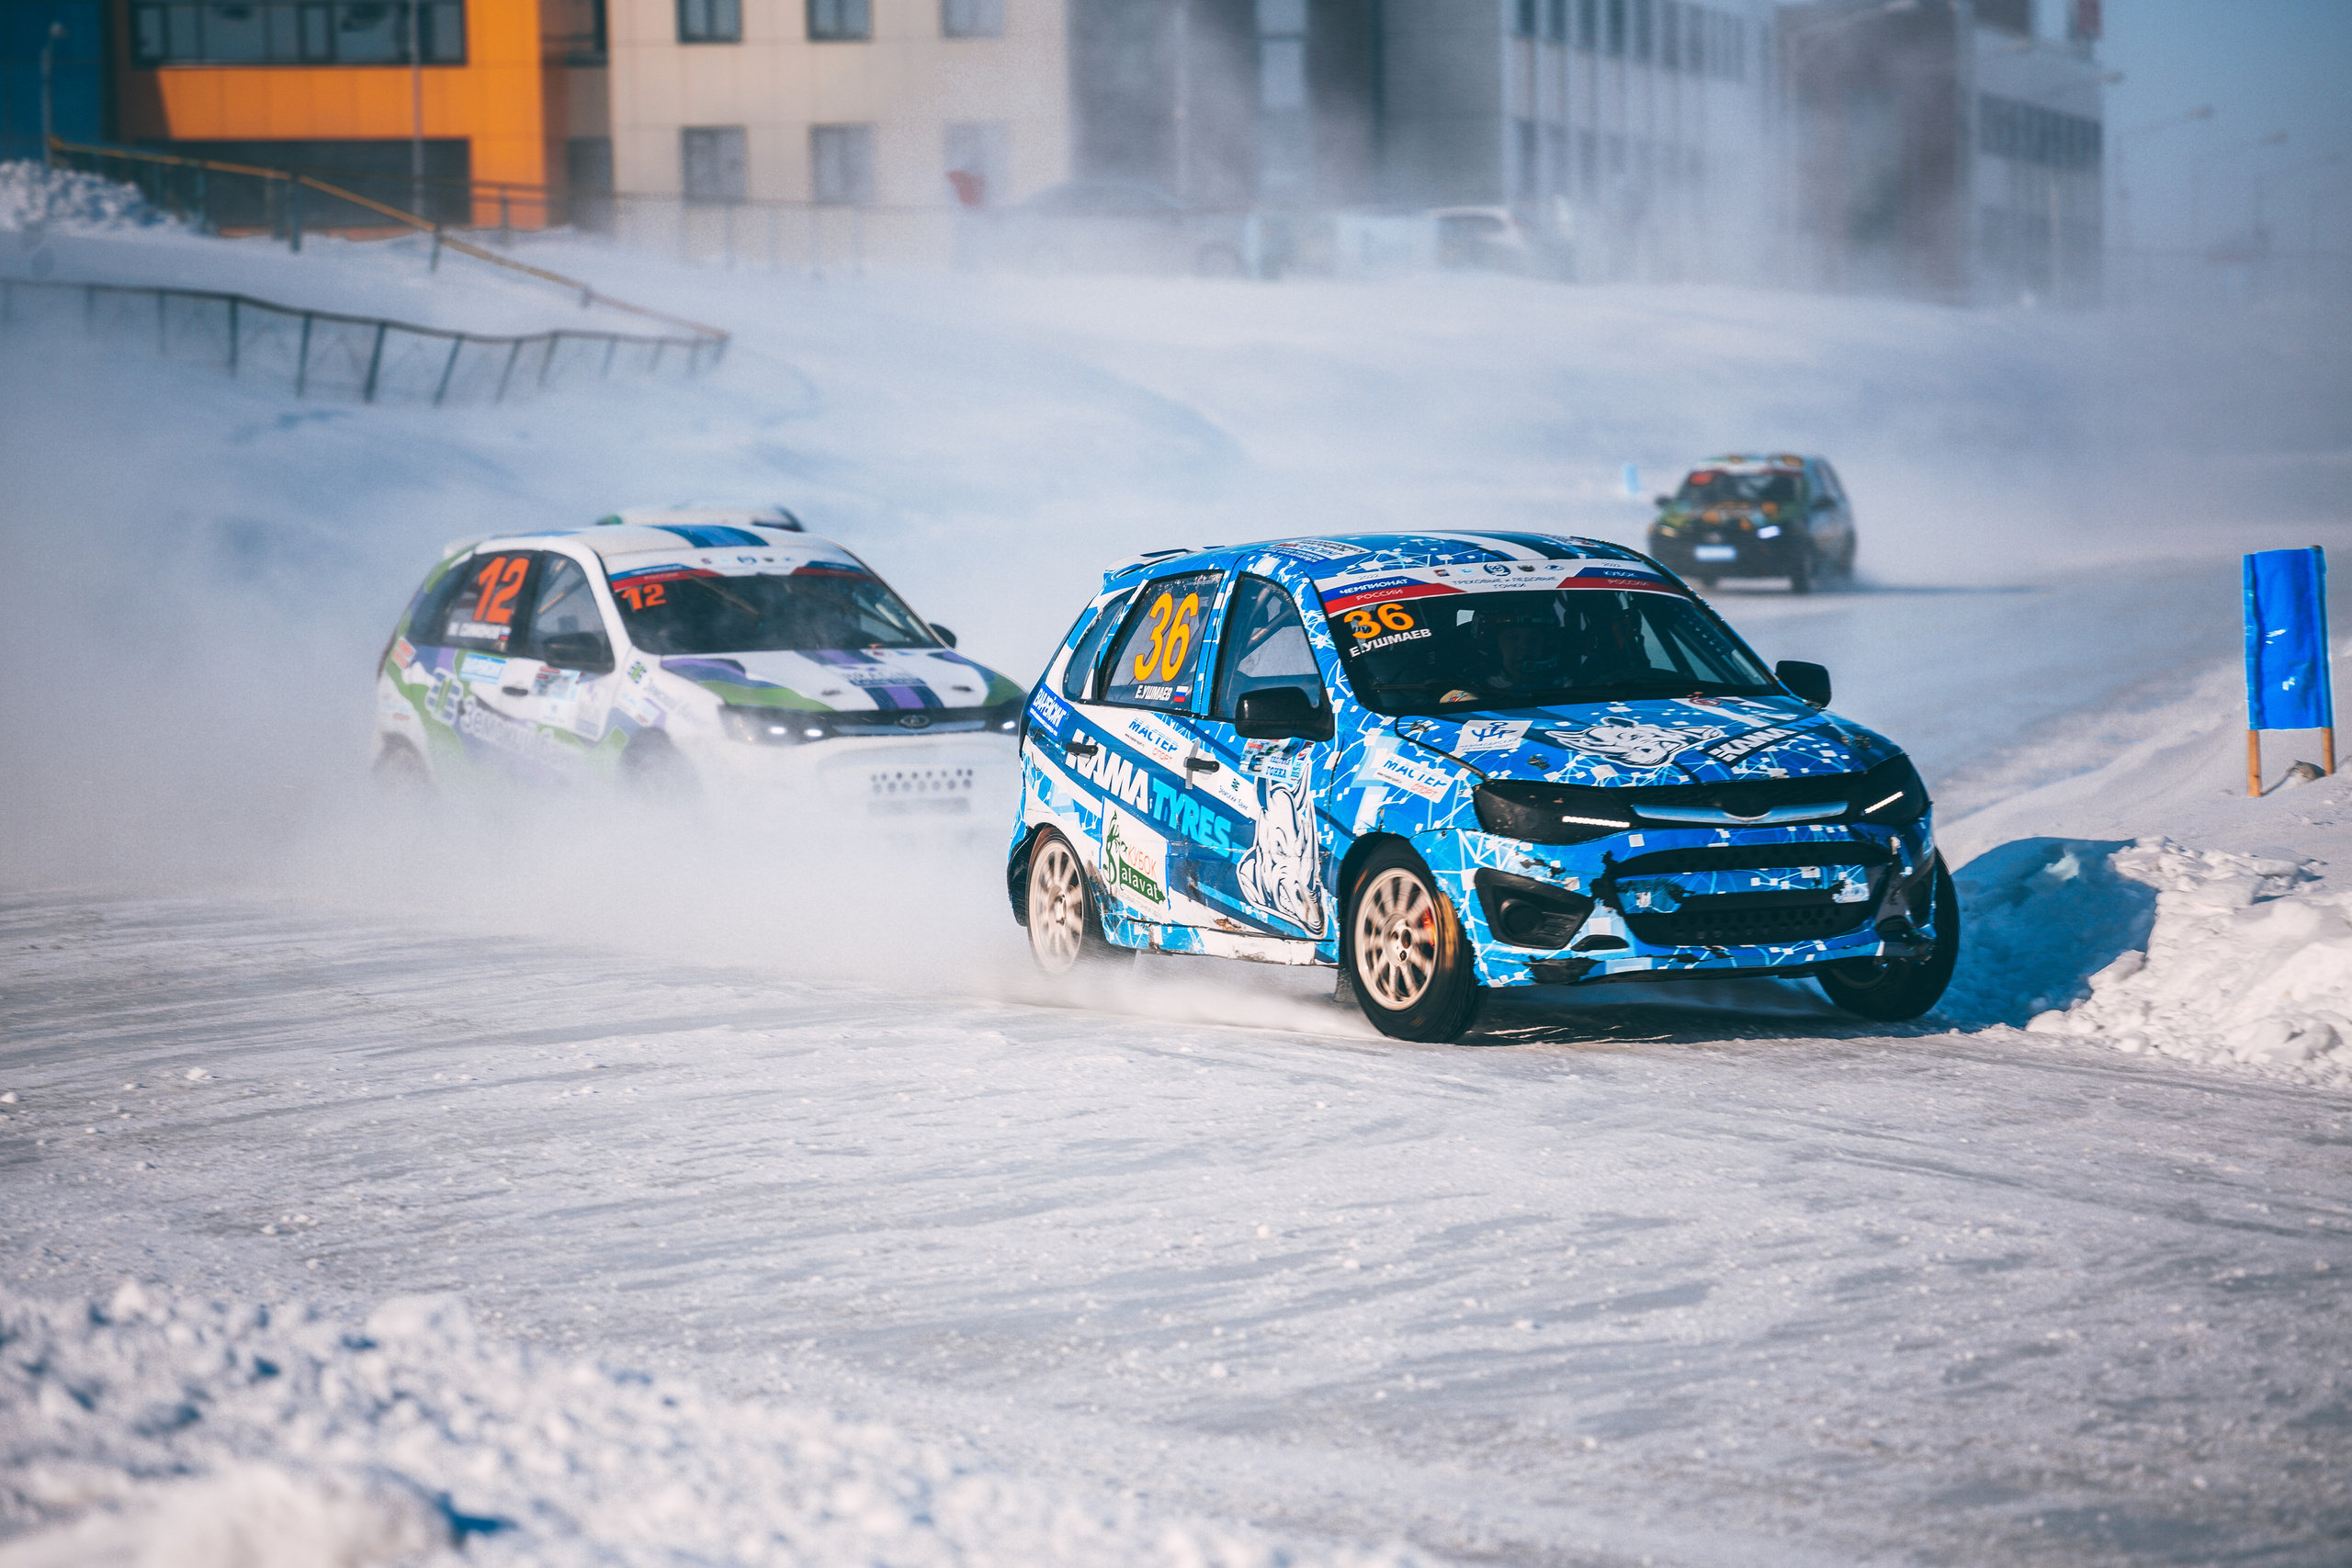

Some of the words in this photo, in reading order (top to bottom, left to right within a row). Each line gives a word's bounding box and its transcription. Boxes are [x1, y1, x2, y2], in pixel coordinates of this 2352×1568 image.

[472, 556, 530, 624] 12
[621, 583, 667, 611] 12
[1339, 578, 1408, 594] ЧЕМПИОНАТ
[1356, 588, 1404, 602] РОССИИ
[1134, 592, 1199, 682] 36
[1343, 603, 1415, 639] 36
[1349, 628, 1432, 658] Е.УШМАЕВ
[1134, 684, 1173, 702] Е.УШМАЕВ
[1128, 717, 1179, 752] МАСТЕР
[1707, 727, 1798, 763] KAMA
[1152, 747, 1173, 764] СПОРТ
[1383, 755, 1450, 788] МАСТЕР
[1065, 728, 1149, 815] KAMA
[1152, 777, 1234, 859] TYRES
[1410, 783, 1439, 798] СПОРТ
[1127, 843, 1158, 880] КУБОК
